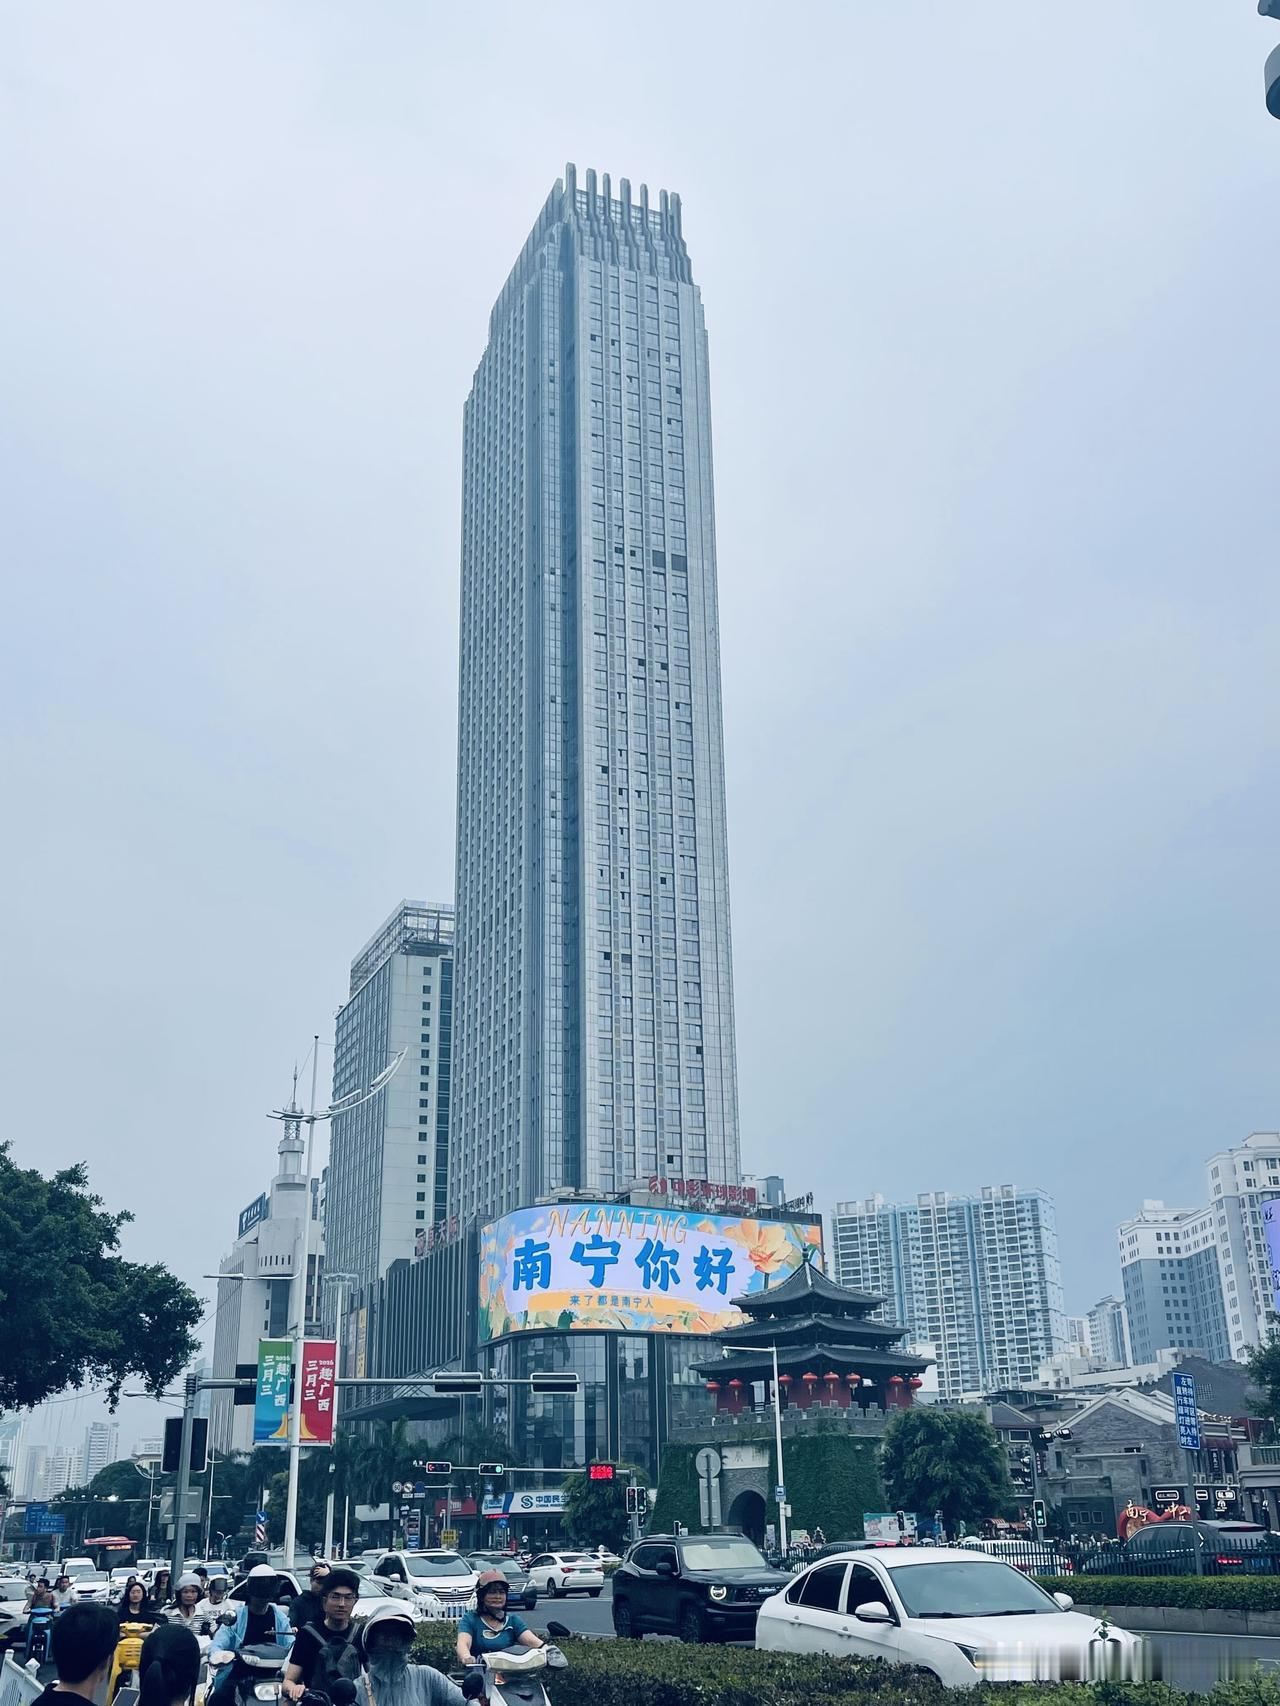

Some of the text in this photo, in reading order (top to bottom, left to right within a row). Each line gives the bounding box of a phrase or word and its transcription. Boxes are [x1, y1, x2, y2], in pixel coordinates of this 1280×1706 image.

[546, 1207, 689, 1245] NANNING
[512, 1234, 736, 1296] 南宁你好
[260, 1354, 275, 1396] 三月三
[274, 1362, 290, 1408] 趣广西
[303, 1360, 319, 1401] 三月三
[317, 1366, 334, 1412] 趣广西
